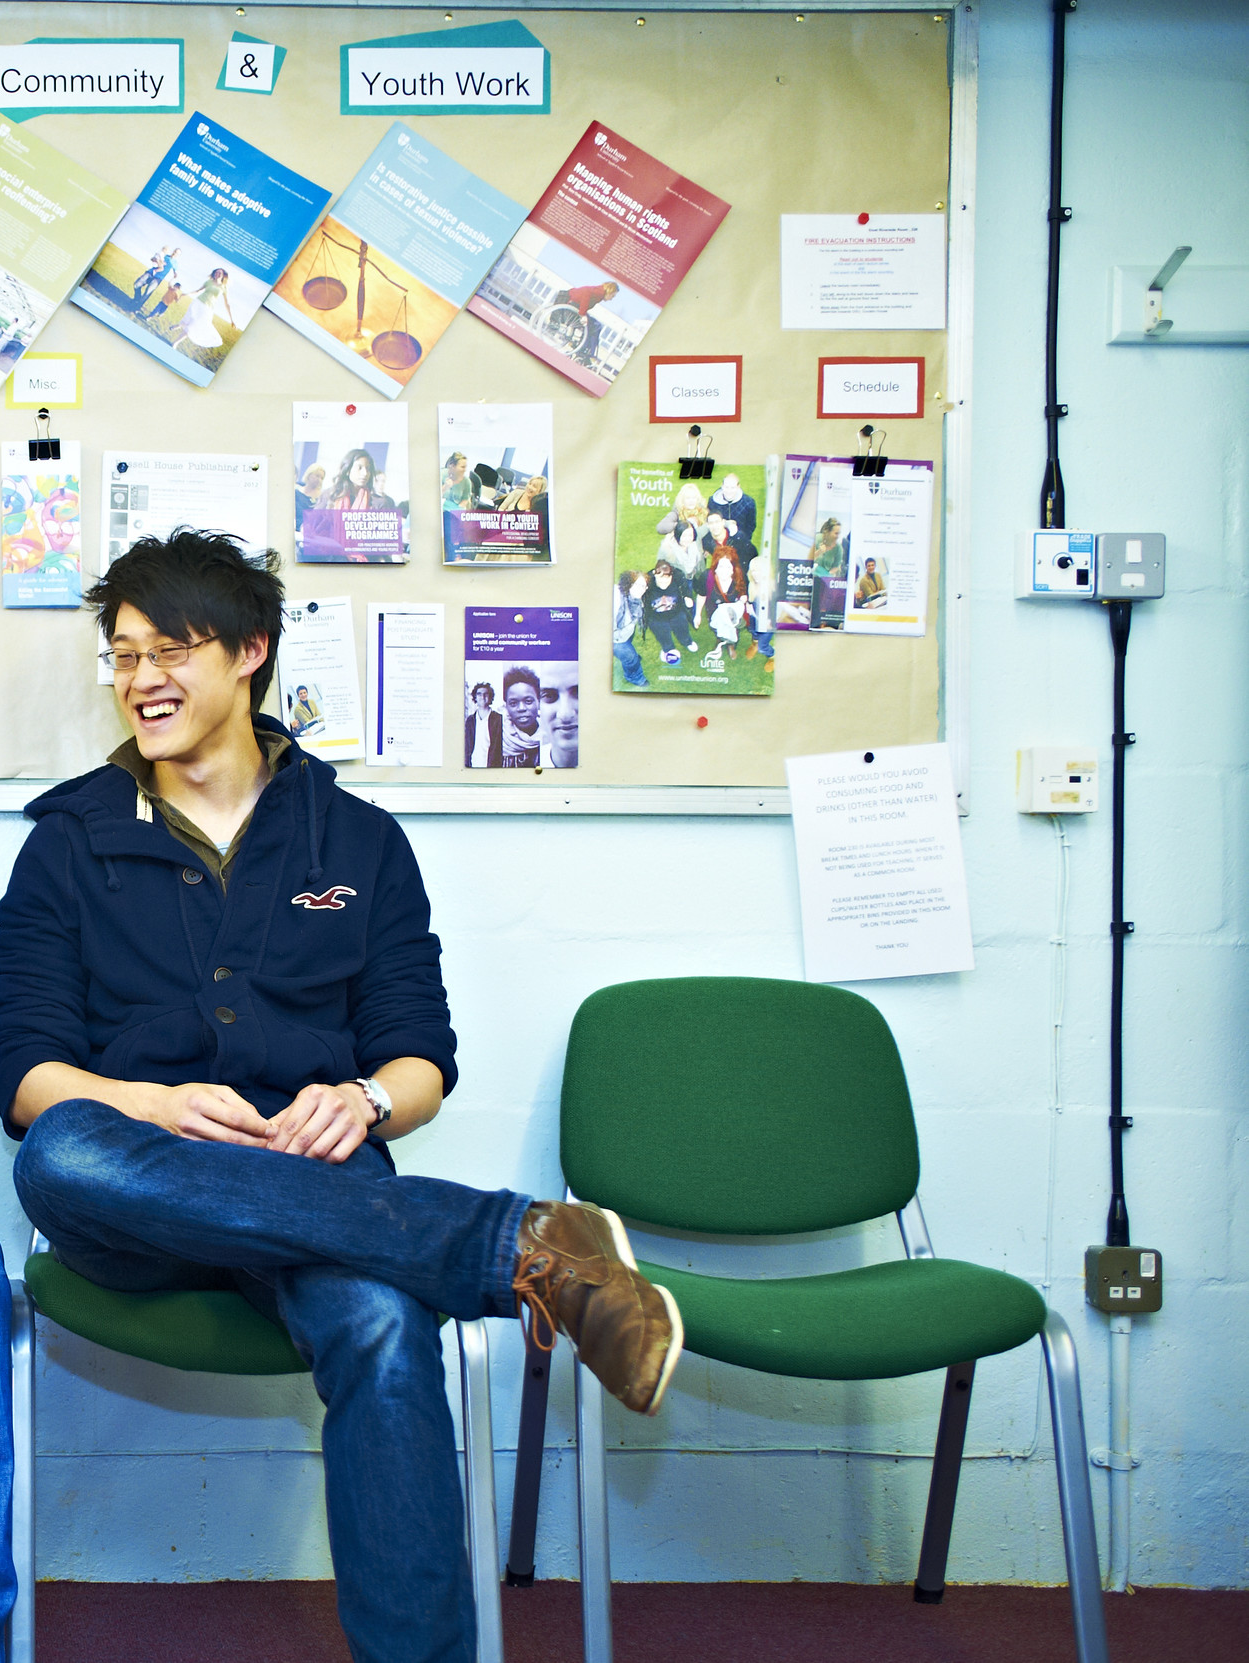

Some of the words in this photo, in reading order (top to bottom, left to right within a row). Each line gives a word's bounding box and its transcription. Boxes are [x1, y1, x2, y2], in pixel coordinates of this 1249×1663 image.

[0, 68, 164, 98] Community
[239, 53, 259, 79] &
[361, 71, 444, 96] Youth
[455, 71, 530, 97] Work
[601, 141, 628, 162] Durham
[167, 162, 200, 189] family
[197, 181, 216, 198] life
[213, 192, 244, 216] work?
[175, 151, 203, 174] What
[200, 167, 233, 194] makes
[229, 187, 272, 220] adoptive
[21, 183, 69, 220] enterprise
[571, 161, 615, 195] Mapping
[611, 186, 645, 213] human
[641, 206, 671, 232] rights
[375, 161, 388, 174] Is
[383, 168, 431, 205] restorative
[426, 198, 460, 227] justice
[455, 218, 495, 251] possible
[564, 172, 628, 218] organisations
[625, 210, 638, 224] in
[635, 217, 678, 249] Scotland
[368, 171, 381, 184] in
[377, 177, 406, 202] cases
[402, 196, 415, 209] of
[412, 203, 443, 229] sexual
[439, 222, 484, 257] violence?
[28, 378, 60, 391] Misc.
[842, 381, 900, 393] Schedule
[671, 386, 720, 398] Classes
[154, 461, 183, 470] House
[188, 462, 238, 473] Publishing
[629, 476, 673, 492] Youth
[880, 487, 912, 495] Durham
[630, 492, 671, 508] Work
[342, 512, 398, 520] PROFESSIONAL
[460, 512, 500, 521] COMMUNITY
[501, 514, 515, 522] AND
[516, 514, 538, 522] YOUTH
[344, 521, 398, 530] DEVELOPMENT
[480, 520, 499, 528] WORK
[501, 521, 508, 529] IN
[510, 522, 539, 530] CONTEXT
[346, 530, 398, 539] PROGRAMMES
[786, 574, 813, 586] Socia
[303, 612, 334, 622] Durham
[700, 658, 725, 669] unite
[658, 674, 728, 683] www.unitetheunion.org
[817, 775, 845, 785] PLEASE
[848, 772, 879, 782] WOULD
[881, 770, 899, 778] YOU
[900, 766, 928, 776] AVOID
[825, 786, 877, 798] CONSUMING
[879, 783, 903, 793] FOOD
[904, 781, 924, 790] AND
[815, 803, 845, 814] DRINKS
[847, 799, 878, 810] (OTHER
[879, 797, 903, 806] THAN
[904, 793, 938, 804] WATER)
[848, 815, 857, 823] IN
[859, 813, 877, 822] THIS
[878, 810, 907, 820] ROOM.
[828, 845, 846, 853] ROOM
[895, 838, 918, 846] DURING
[918, 835, 935, 843] MOST
[820, 855, 839, 863] BREAK
[840, 853, 857, 861] TIMES
[914, 845, 932, 853] WHEN
[837, 862, 855, 870] BEING
[855, 860, 871, 868] USED
[922, 853, 943, 861] SERVES
[853, 870, 860, 878] AS
[867, 867, 895, 876] COMMON
[831, 895, 852, 903] PLEASE
[852, 892, 886, 901] REMEMBER
[895, 889, 915, 897] EMPTY
[926, 886, 942, 894] USED
[869, 900, 894, 909] BOTTLES
[908, 897, 926, 906] PLACE
[826, 912, 865, 922] APPROPRIATE
[881, 908, 910, 917] PROVIDED
[932, 904, 950, 912] ROOM
[880, 918, 891, 926] THE
[875, 943, 894, 951] THANK
[895, 940, 909, 949] YOU
